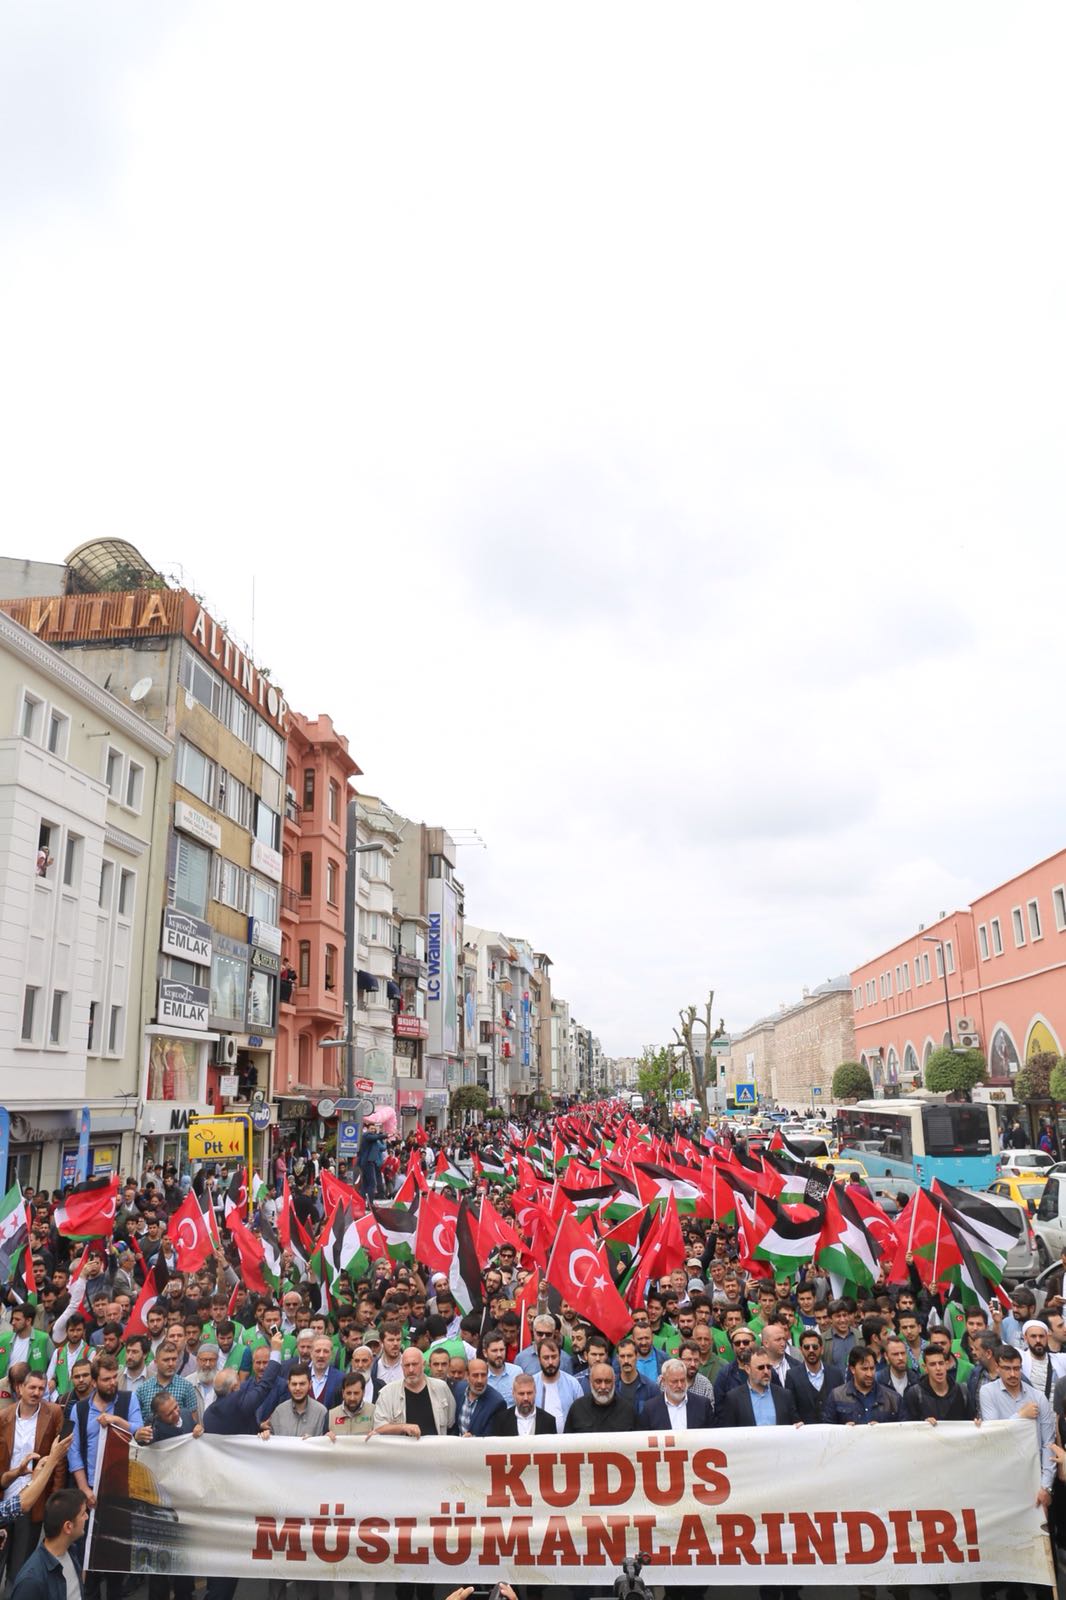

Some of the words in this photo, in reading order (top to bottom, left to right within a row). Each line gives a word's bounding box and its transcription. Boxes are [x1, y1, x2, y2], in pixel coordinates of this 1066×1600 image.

[167, 930, 208, 957] EMLAK
[428, 980, 441, 1001] LC
[163, 1001, 205, 1022] EMLAK
[204, 1141, 223, 1154] Ptt
[486, 1436, 731, 1507] KUDÜS
[252, 1501, 981, 1566] MÜSLÜMANLARINDIR!
